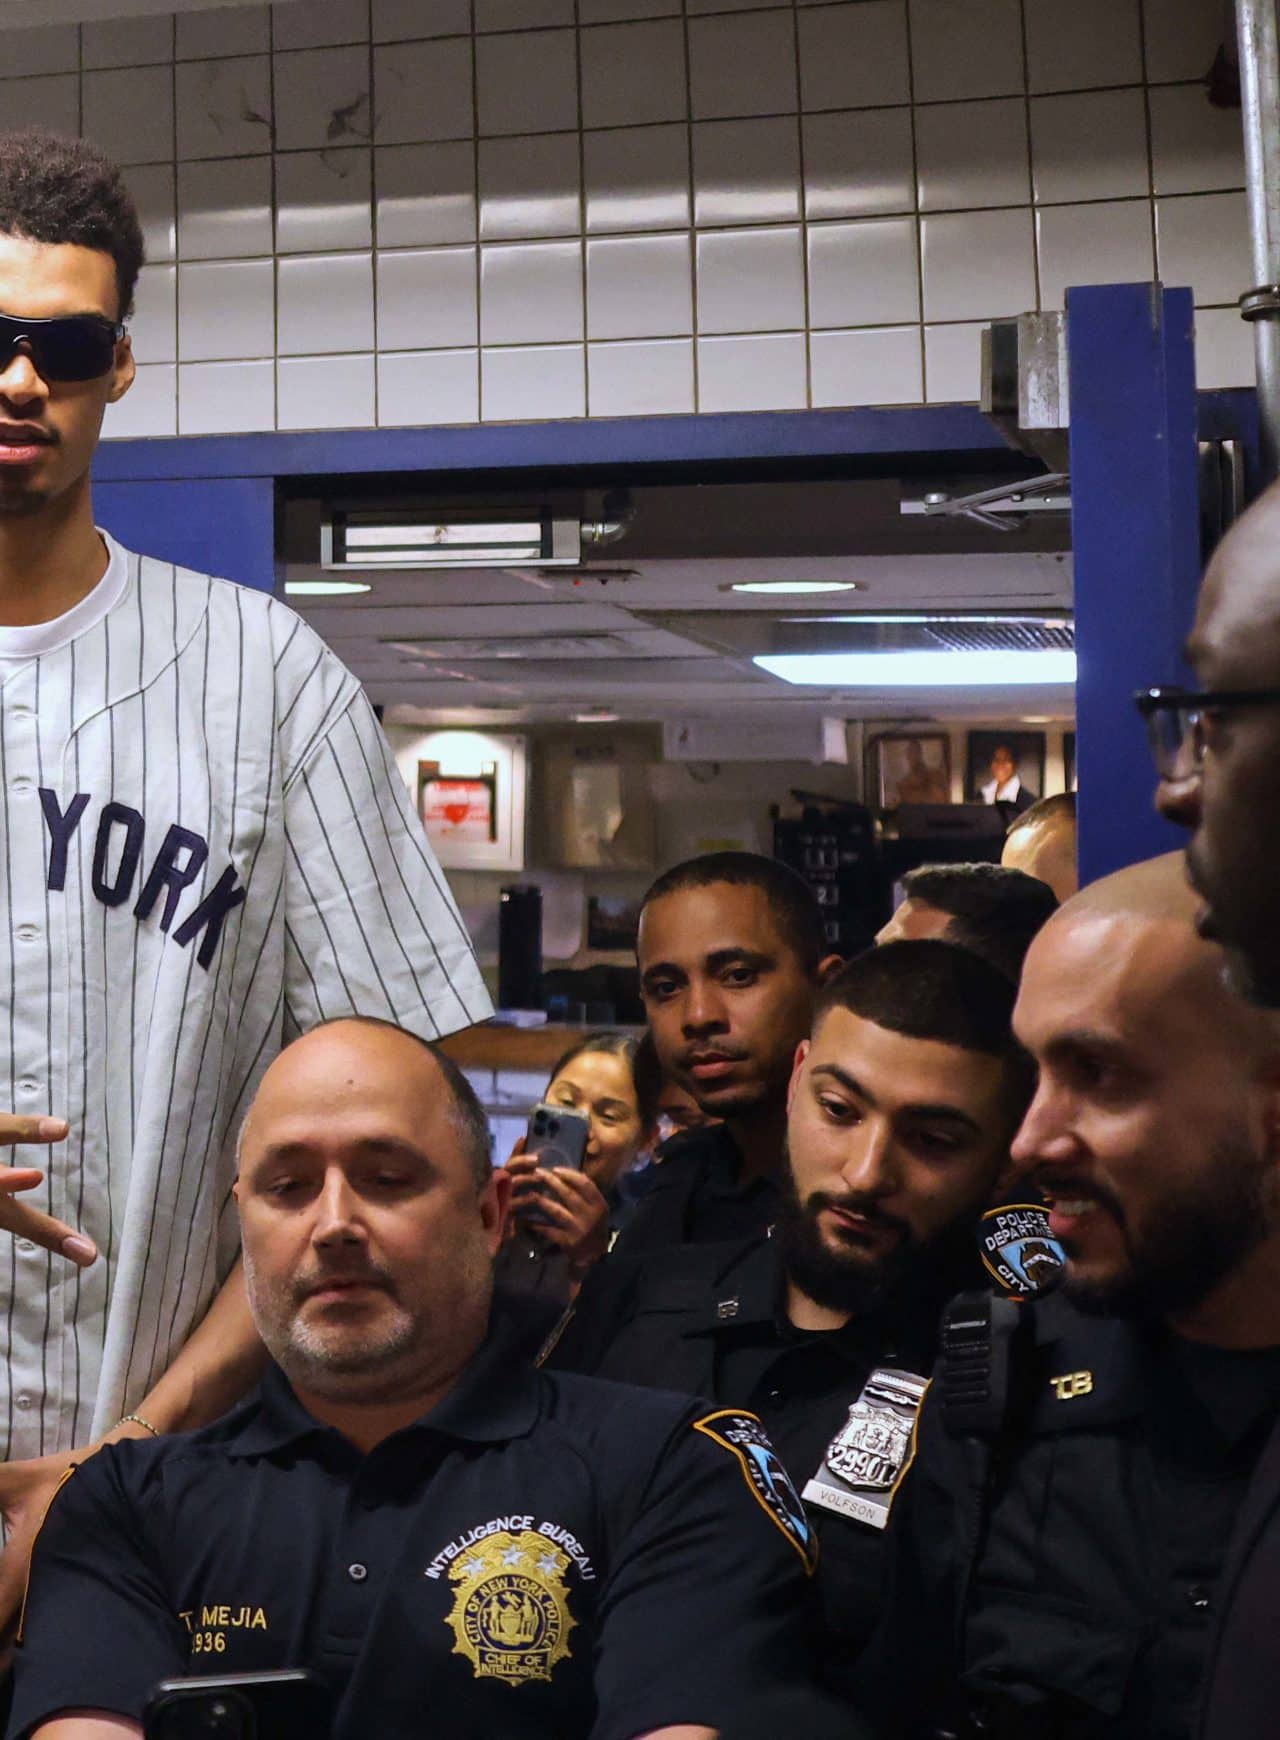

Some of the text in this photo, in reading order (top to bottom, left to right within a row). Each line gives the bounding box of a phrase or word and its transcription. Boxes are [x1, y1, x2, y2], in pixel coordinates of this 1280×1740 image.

[38, 786, 246, 971] YORK
[996, 1211, 1048, 1230] POLICE
[997, 1264, 1029, 1292] CITY
[1050, 1370, 1094, 1400] TB
[819, 1489, 876, 1520] VOLFSON
[424, 1515, 597, 1581] INTELLIGENCE BUREAU
[478, 1576, 509, 1599] NEW
[511, 1576, 548, 1600] YORK
[201, 1604, 268, 1631] MEJIA
[467, 1595, 483, 1613] OF
[191, 1631, 227, 1654] 936
[465, 1616, 482, 1643] CITY
[484, 1653, 542, 1666] CHIEF OF
